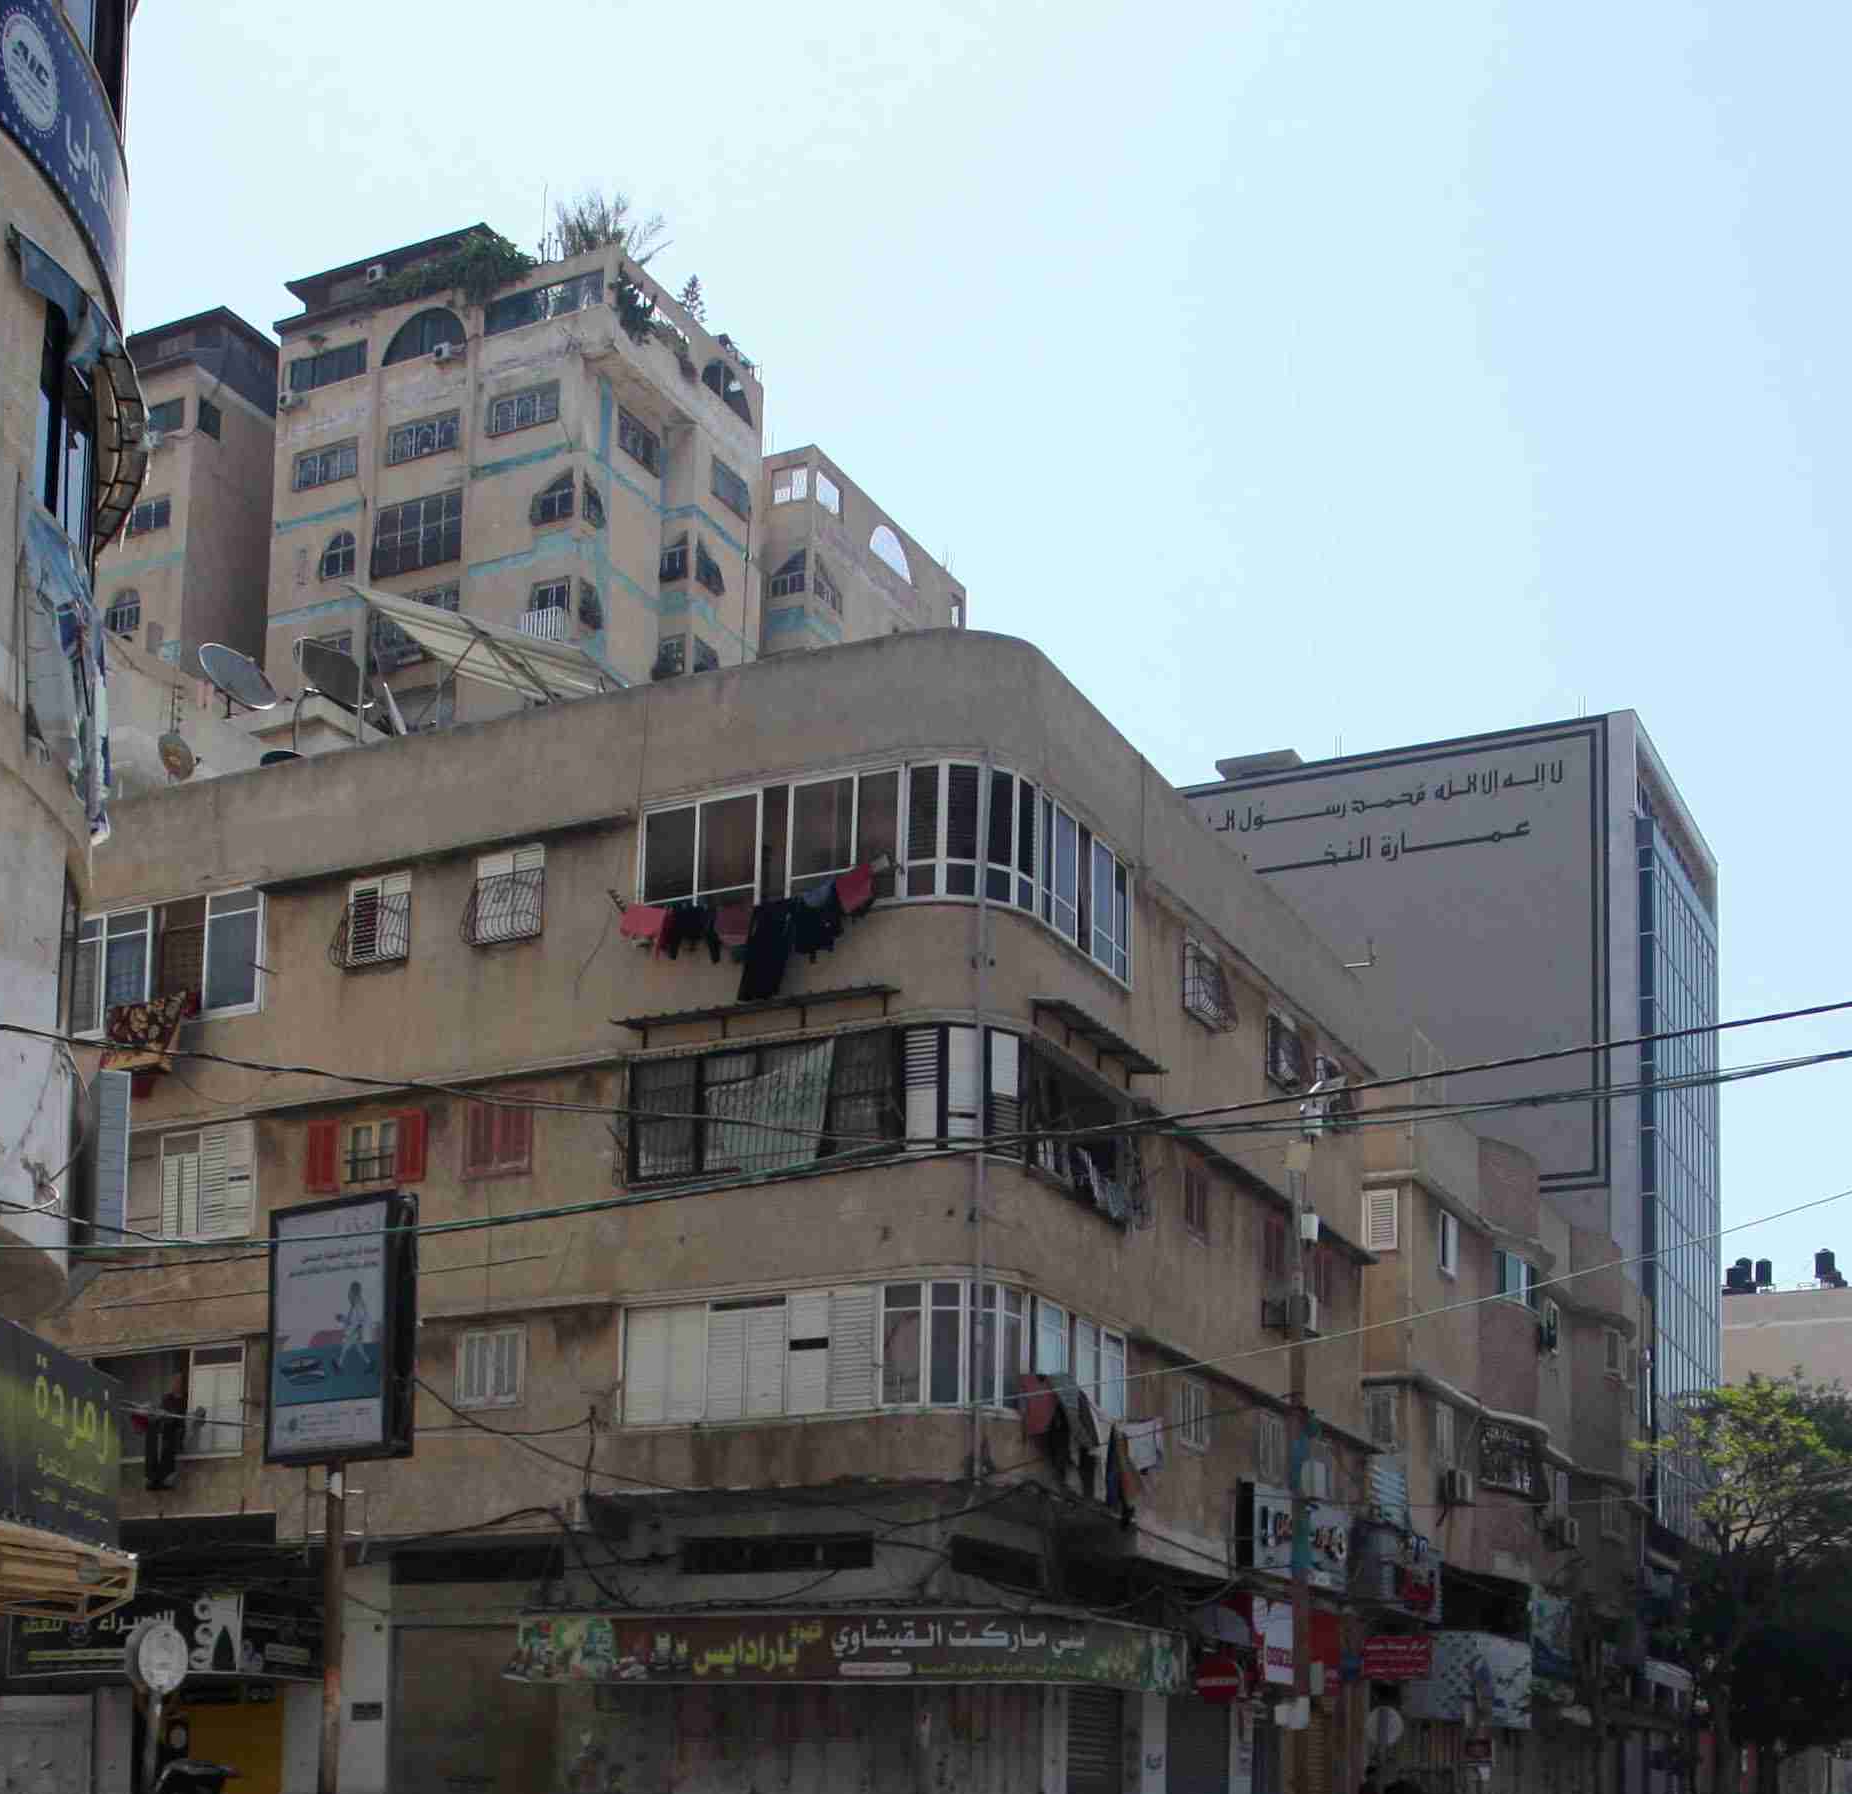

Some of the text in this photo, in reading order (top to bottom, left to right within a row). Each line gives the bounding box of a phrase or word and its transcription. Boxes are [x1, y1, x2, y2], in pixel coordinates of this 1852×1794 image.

[1549, 759, 1563, 784] لا
[1351, 785, 1426, 815] محمد
[1207, 808, 1236, 832] ال
[1240, 801, 1346, 833] رسول
[1380, 820, 1531, 861] عمارة
[948, 1619, 1047, 1653] ماركت
